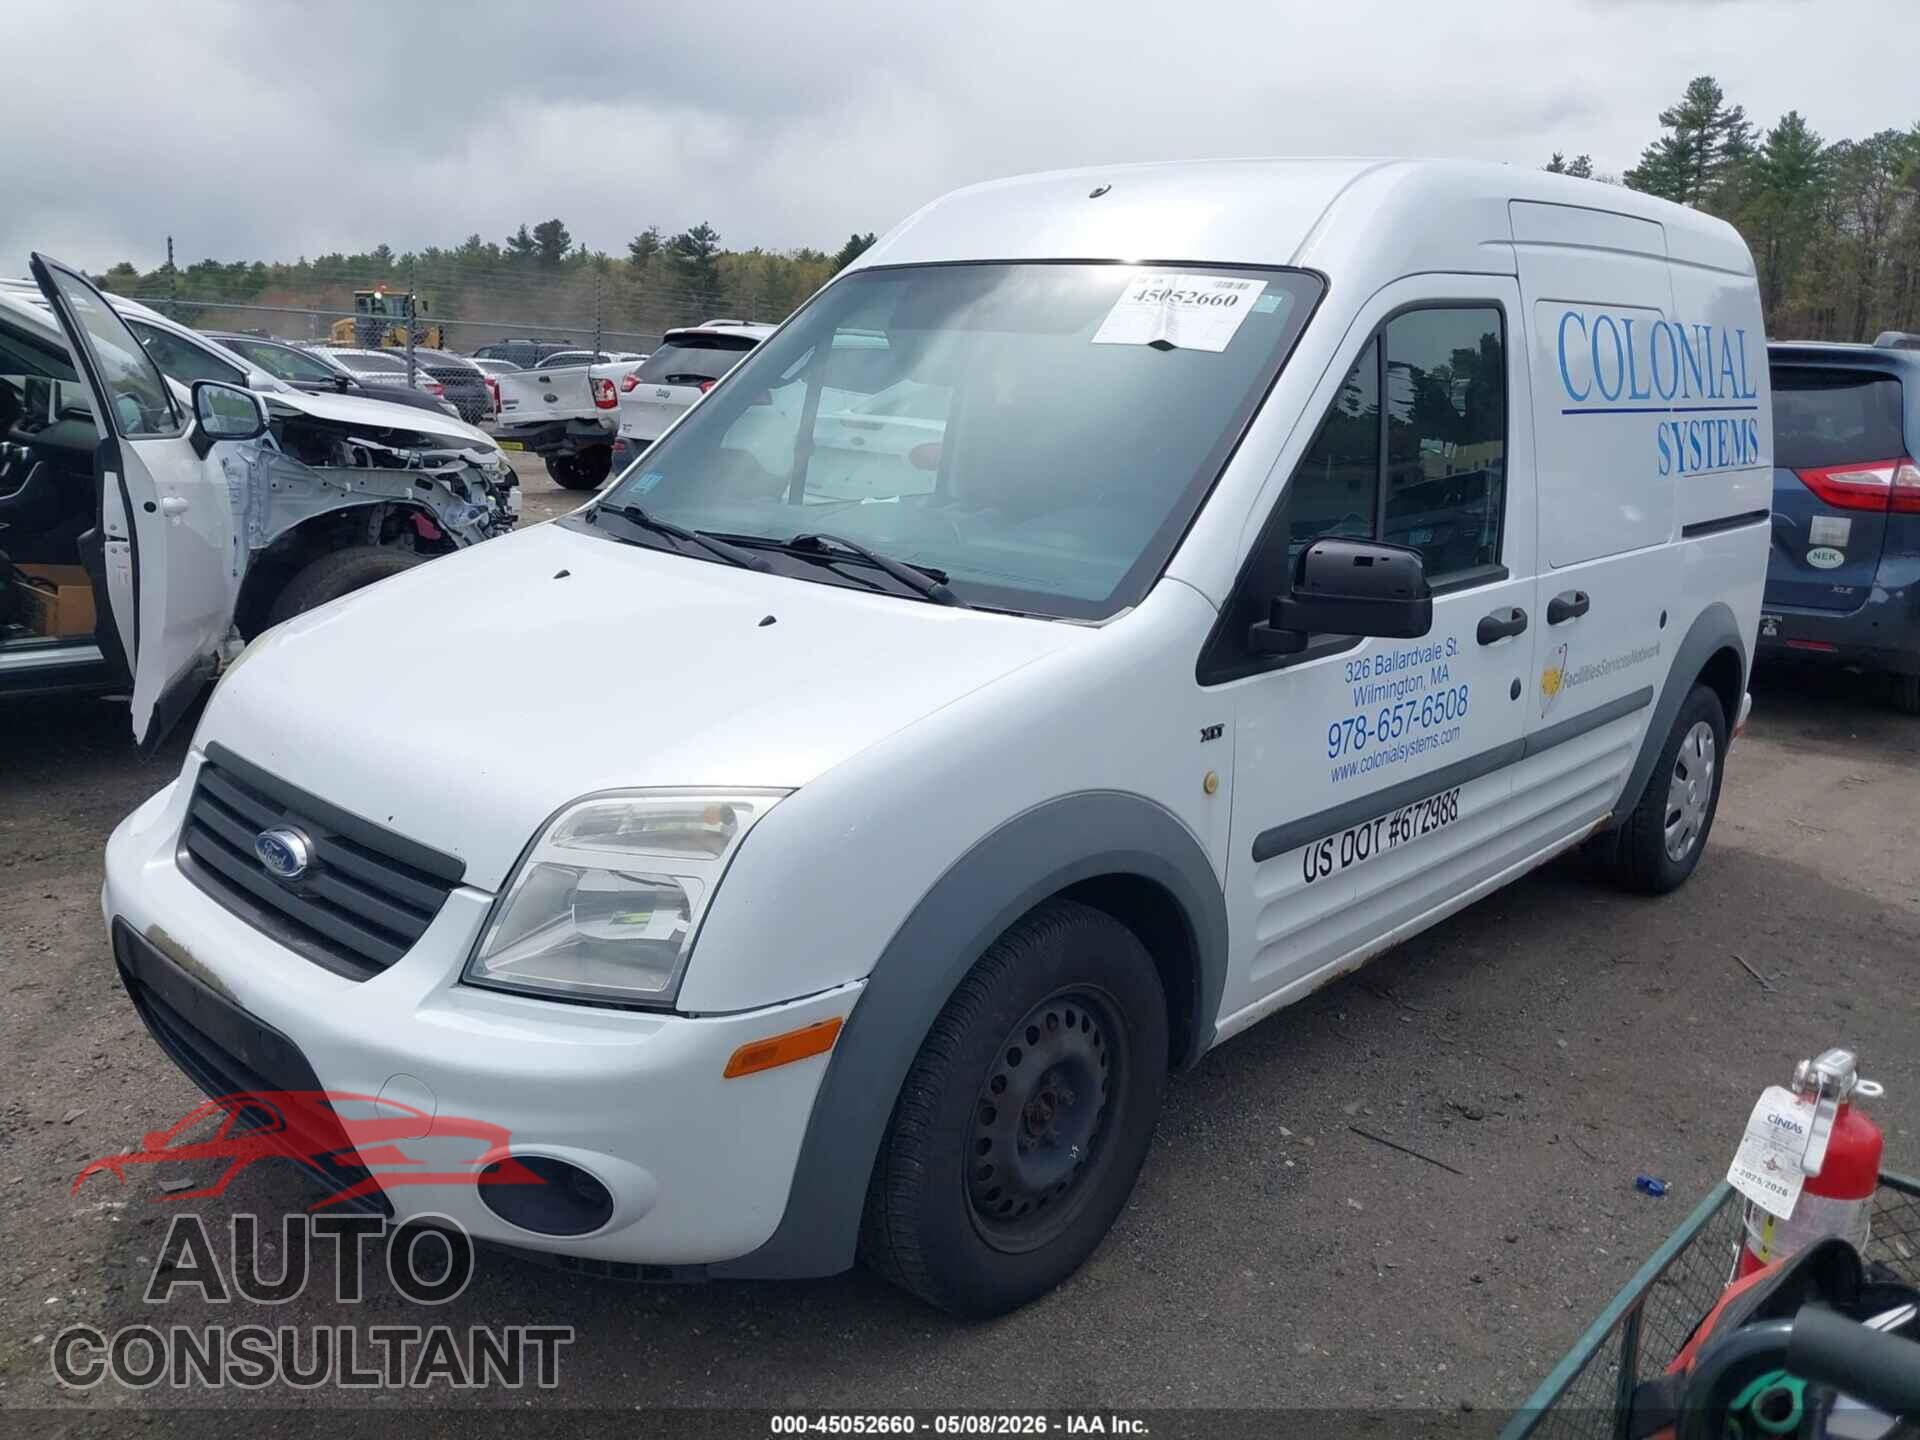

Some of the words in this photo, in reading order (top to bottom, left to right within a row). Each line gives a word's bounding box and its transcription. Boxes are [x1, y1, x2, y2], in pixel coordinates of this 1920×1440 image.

[1133, 288, 1239, 307] 45052660
[1558, 311, 1757, 402] COLONIAL
[1658, 418, 1759, 477] SYSTEMS
[1812, 551, 1837, 562] NEK
[1345, 658, 1371, 684] 326
[1375, 642, 1442, 676] Ballardvale
[1446, 636, 1460, 658] St.
[1353, 674, 1426, 707] Wilmington,
[1430, 664, 1449, 684] MA
[1200, 722, 1225, 743] XLT
[1328, 684, 1469, 760] 978-657-6508
[1330, 726, 1461, 783] www.colonialsystems.com
[1303, 837, 1333, 884] US
[1341, 817, 1386, 869] DOT
[1388, 787, 1461, 849] #672988
